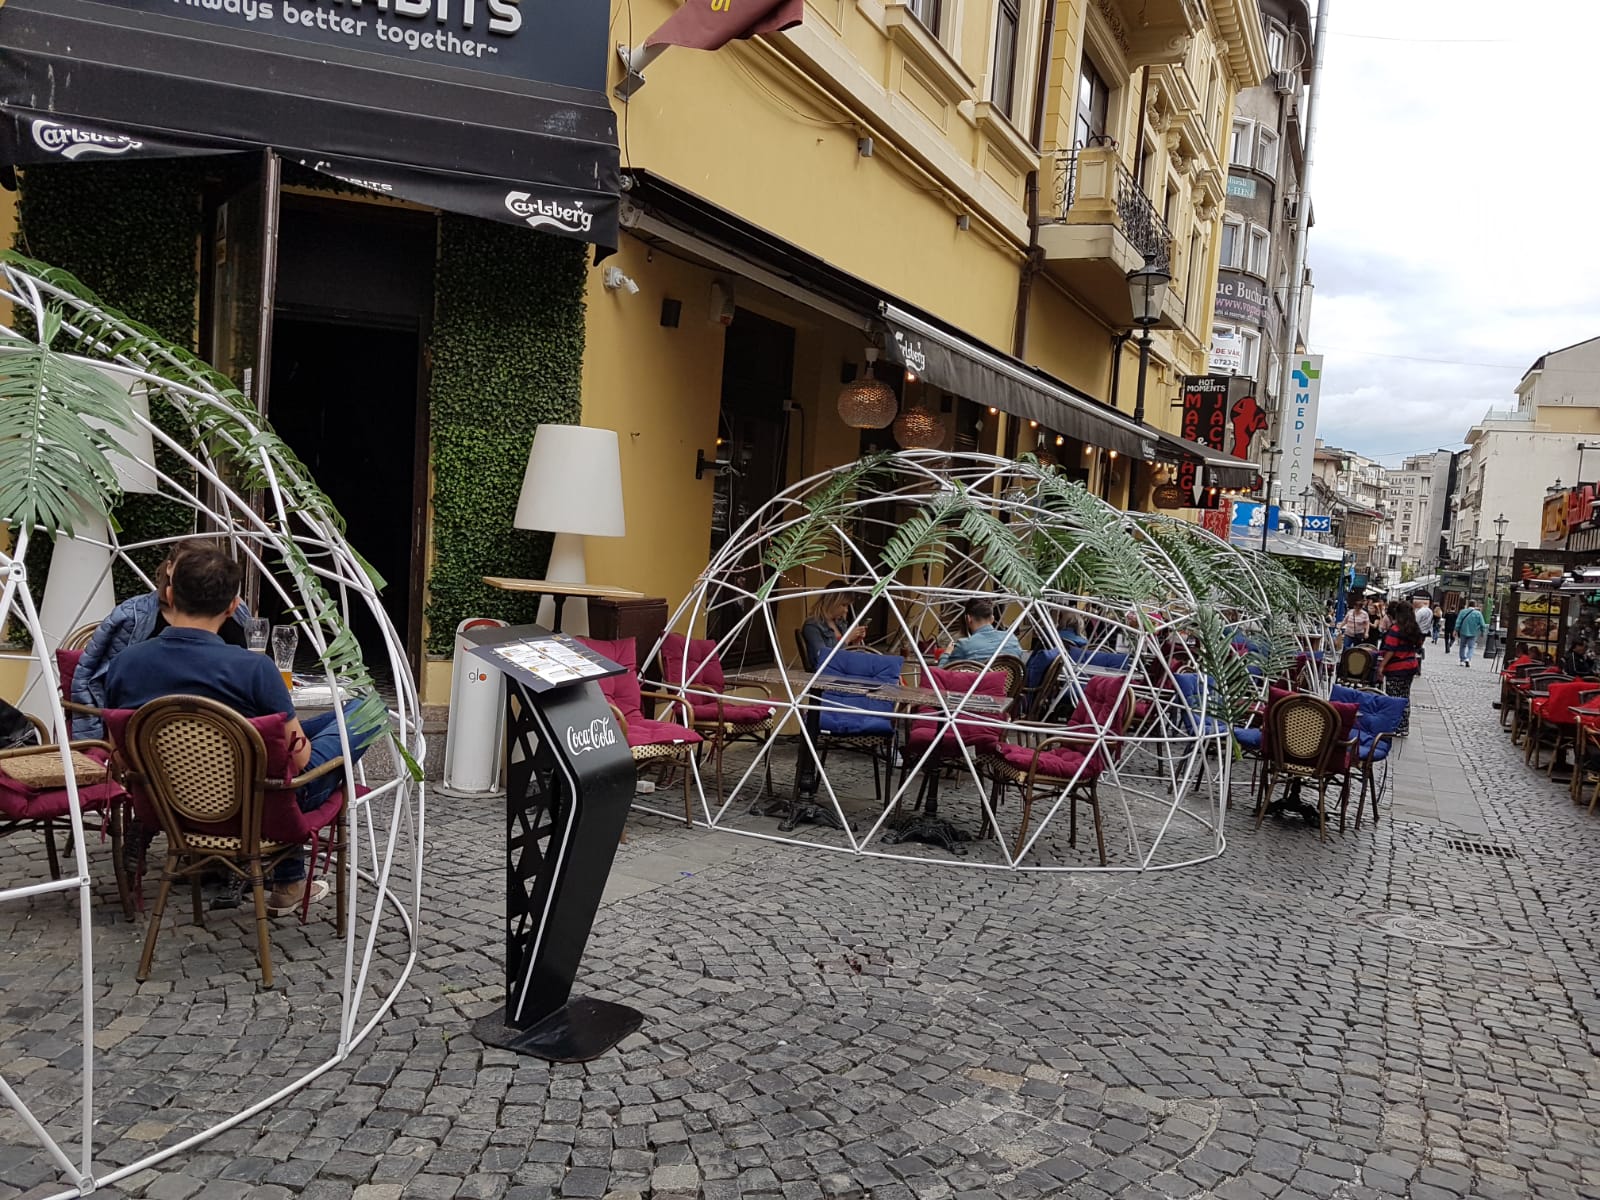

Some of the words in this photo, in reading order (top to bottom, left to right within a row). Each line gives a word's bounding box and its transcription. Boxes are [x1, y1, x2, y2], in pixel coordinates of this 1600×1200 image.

[172, 0, 274, 21] ways
[283, 1, 367, 36] better
[505, 190, 594, 232] Carlsberg
[1187, 384, 1226, 393] MOMENTS
[1290, 393, 1309, 496] MEDICARE
[468, 668, 487, 683] glo
[567, 716, 616, 756] Coca-Cola
